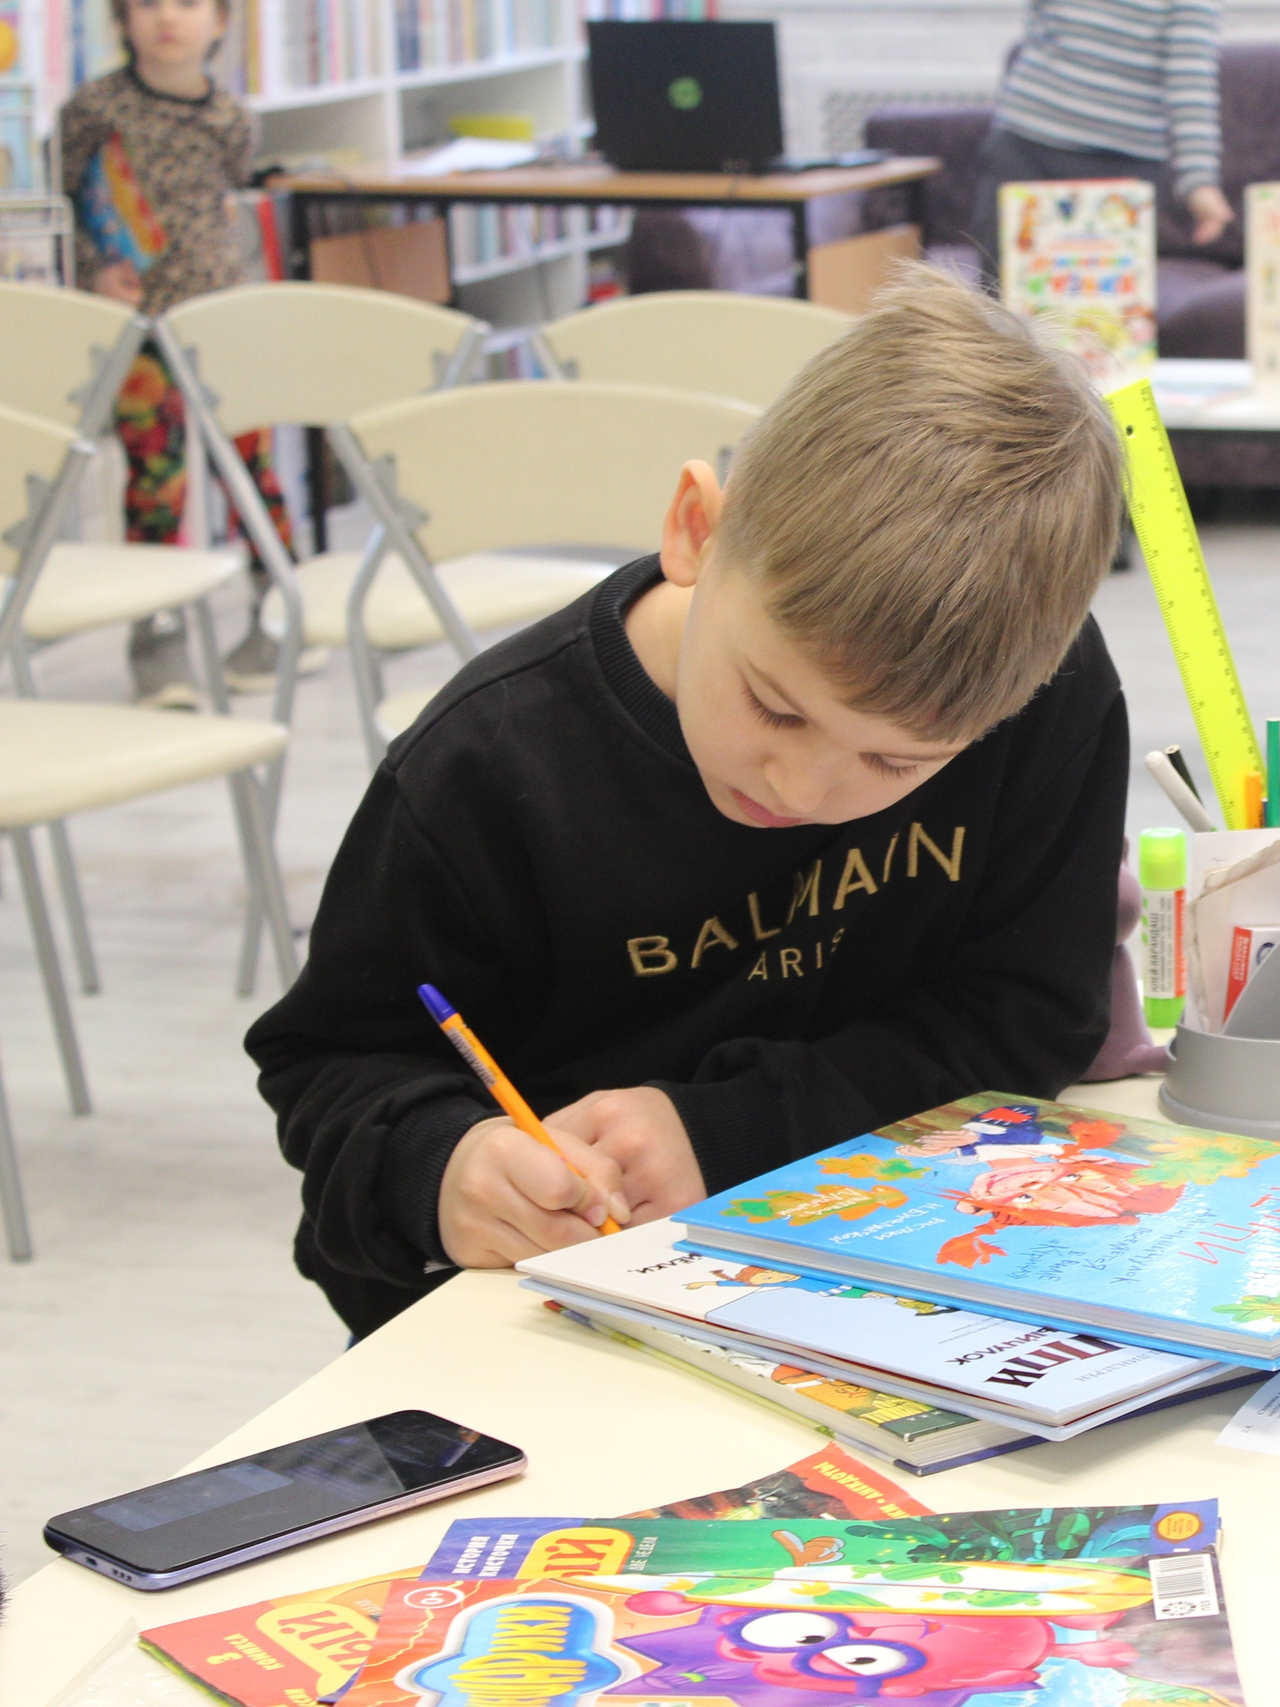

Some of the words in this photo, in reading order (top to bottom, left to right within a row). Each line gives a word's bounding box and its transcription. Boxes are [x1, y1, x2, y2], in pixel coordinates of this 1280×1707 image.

[627, 821, 966, 978] BALMAIN
[812, 1461, 884, 1500] АНЕКДОТЫ
[452, 1535, 491, 1574] ИСТОРИЯ
[478, 1534, 520, 1577] КИСТОЧКИ
[206, 1652, 243, 1665] 3
[223, 1633, 285, 1671] КОМИКСА
